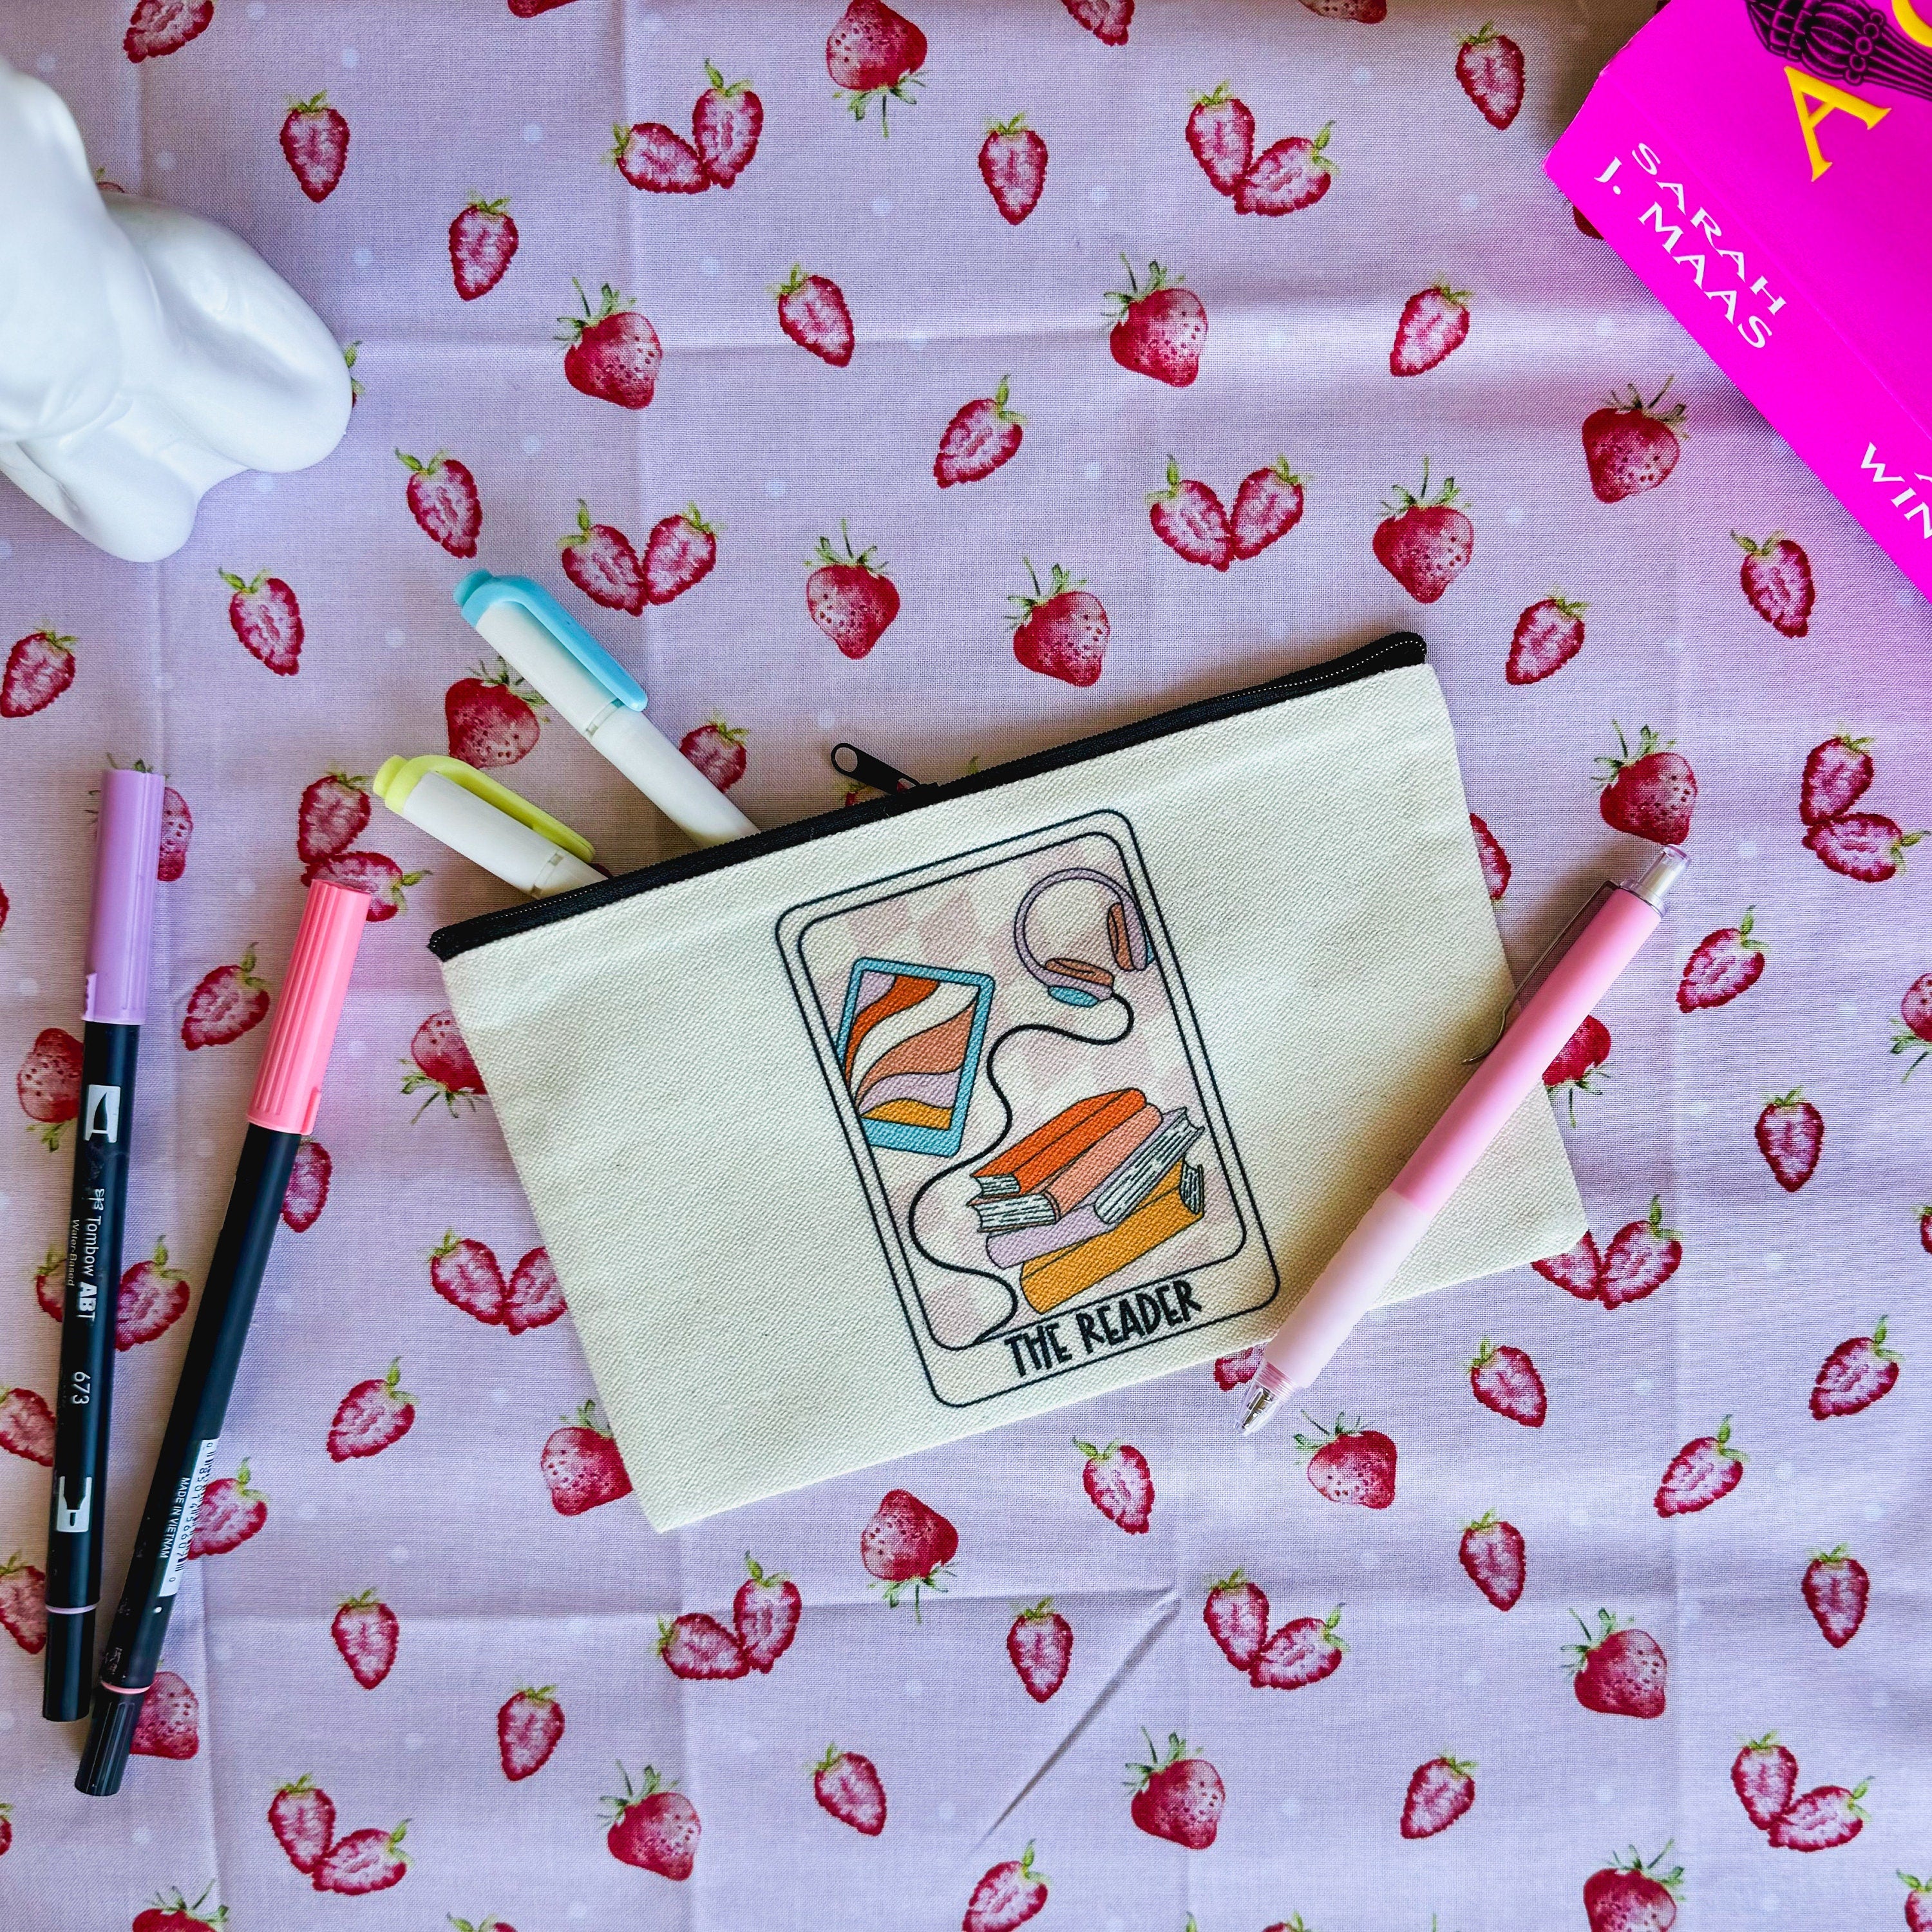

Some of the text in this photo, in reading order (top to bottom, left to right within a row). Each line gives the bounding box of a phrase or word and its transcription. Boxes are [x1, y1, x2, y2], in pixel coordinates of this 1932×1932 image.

[1784, 66, 1892, 182] A
[1594, 156, 1772, 348] J. MAAS
[1632, 142, 1786, 315] SARAH
[66, 1219, 80, 1287] Water-Based
[76, 1215, 101, 1321] Tombow ABT
[1004, 1280, 1202, 1377] THE READER
[72, 1371, 91, 1405] 673
[160, 1477, 191, 1558] MADE IN VIETNAM
